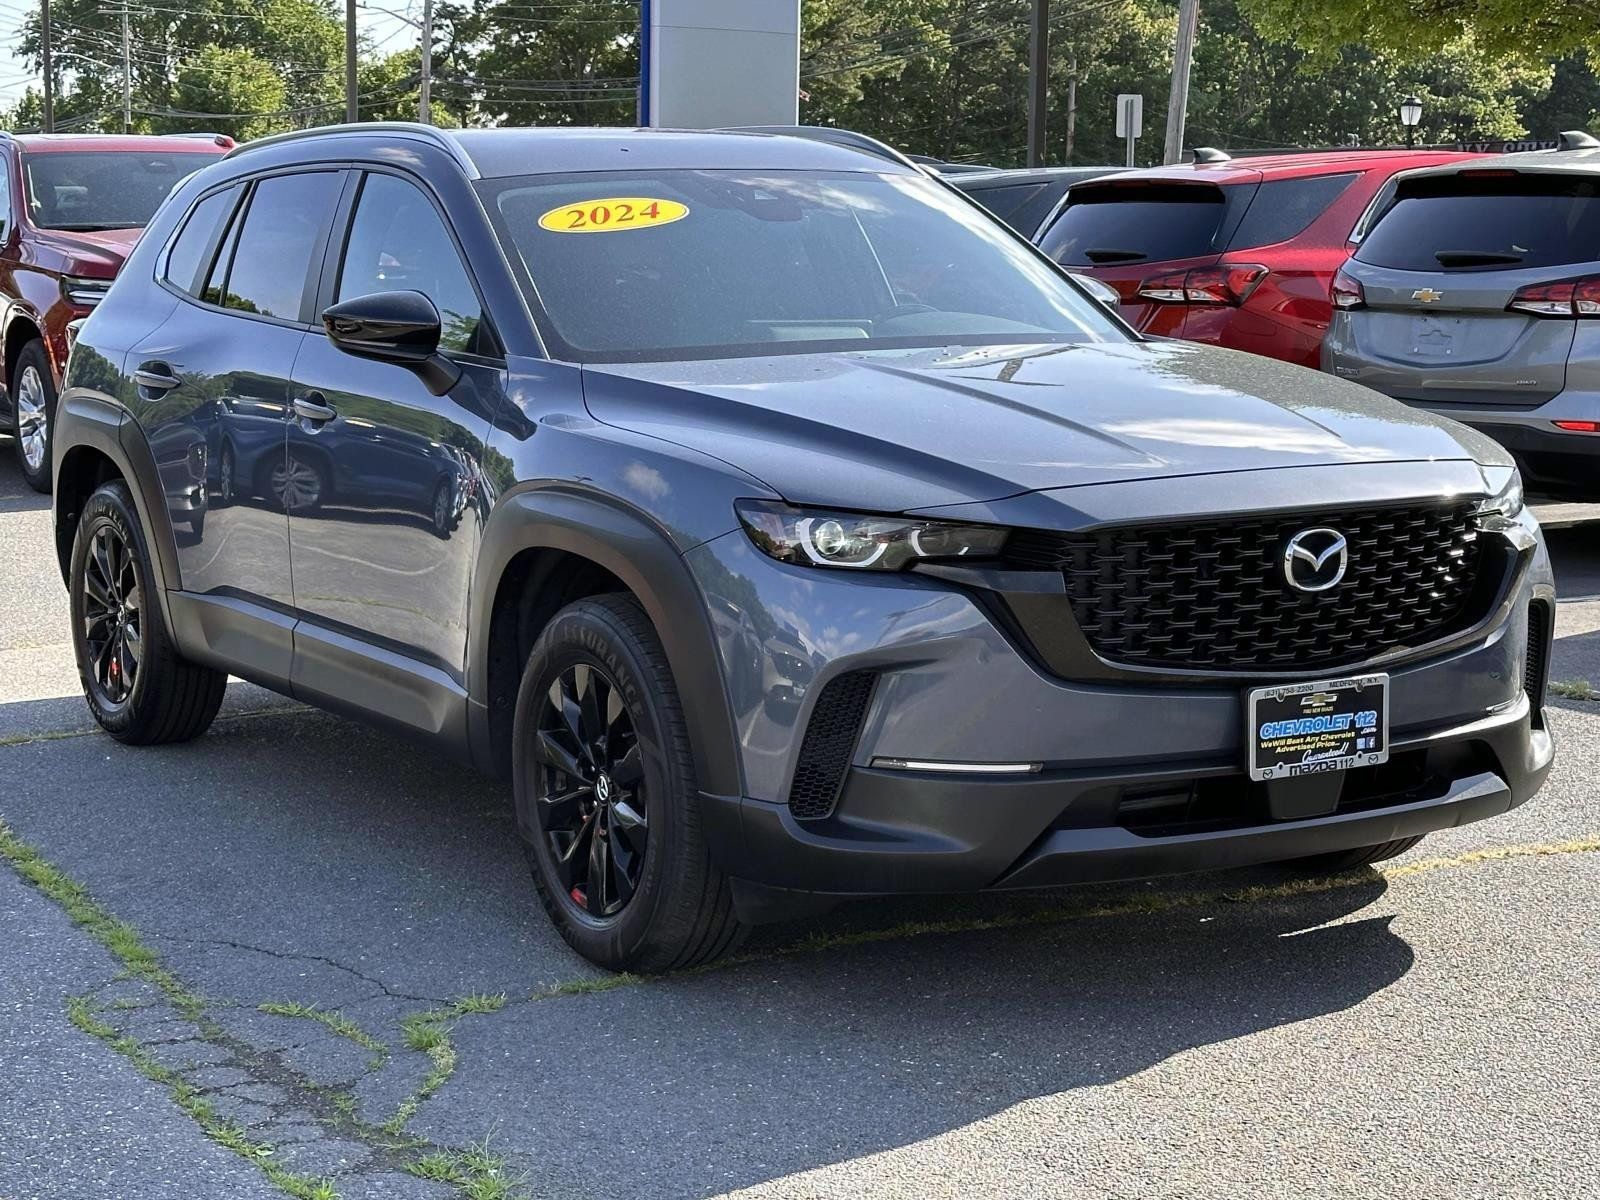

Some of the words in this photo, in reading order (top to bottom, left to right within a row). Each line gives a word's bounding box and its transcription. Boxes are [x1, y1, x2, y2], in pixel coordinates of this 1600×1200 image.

[567, 202, 661, 229] 2024
[559, 623, 644, 718] ASSURANCE
[1260, 713, 1354, 739] CHEVROLET
[1354, 711, 1377, 728] 112
[1275, 743, 1316, 754] Advertised
[1286, 736, 1304, 746] Beat
[1305, 735, 1319, 745] Any
[1320, 731, 1355, 742] Chevrolet
[1339, 758, 1354, 769] 112
